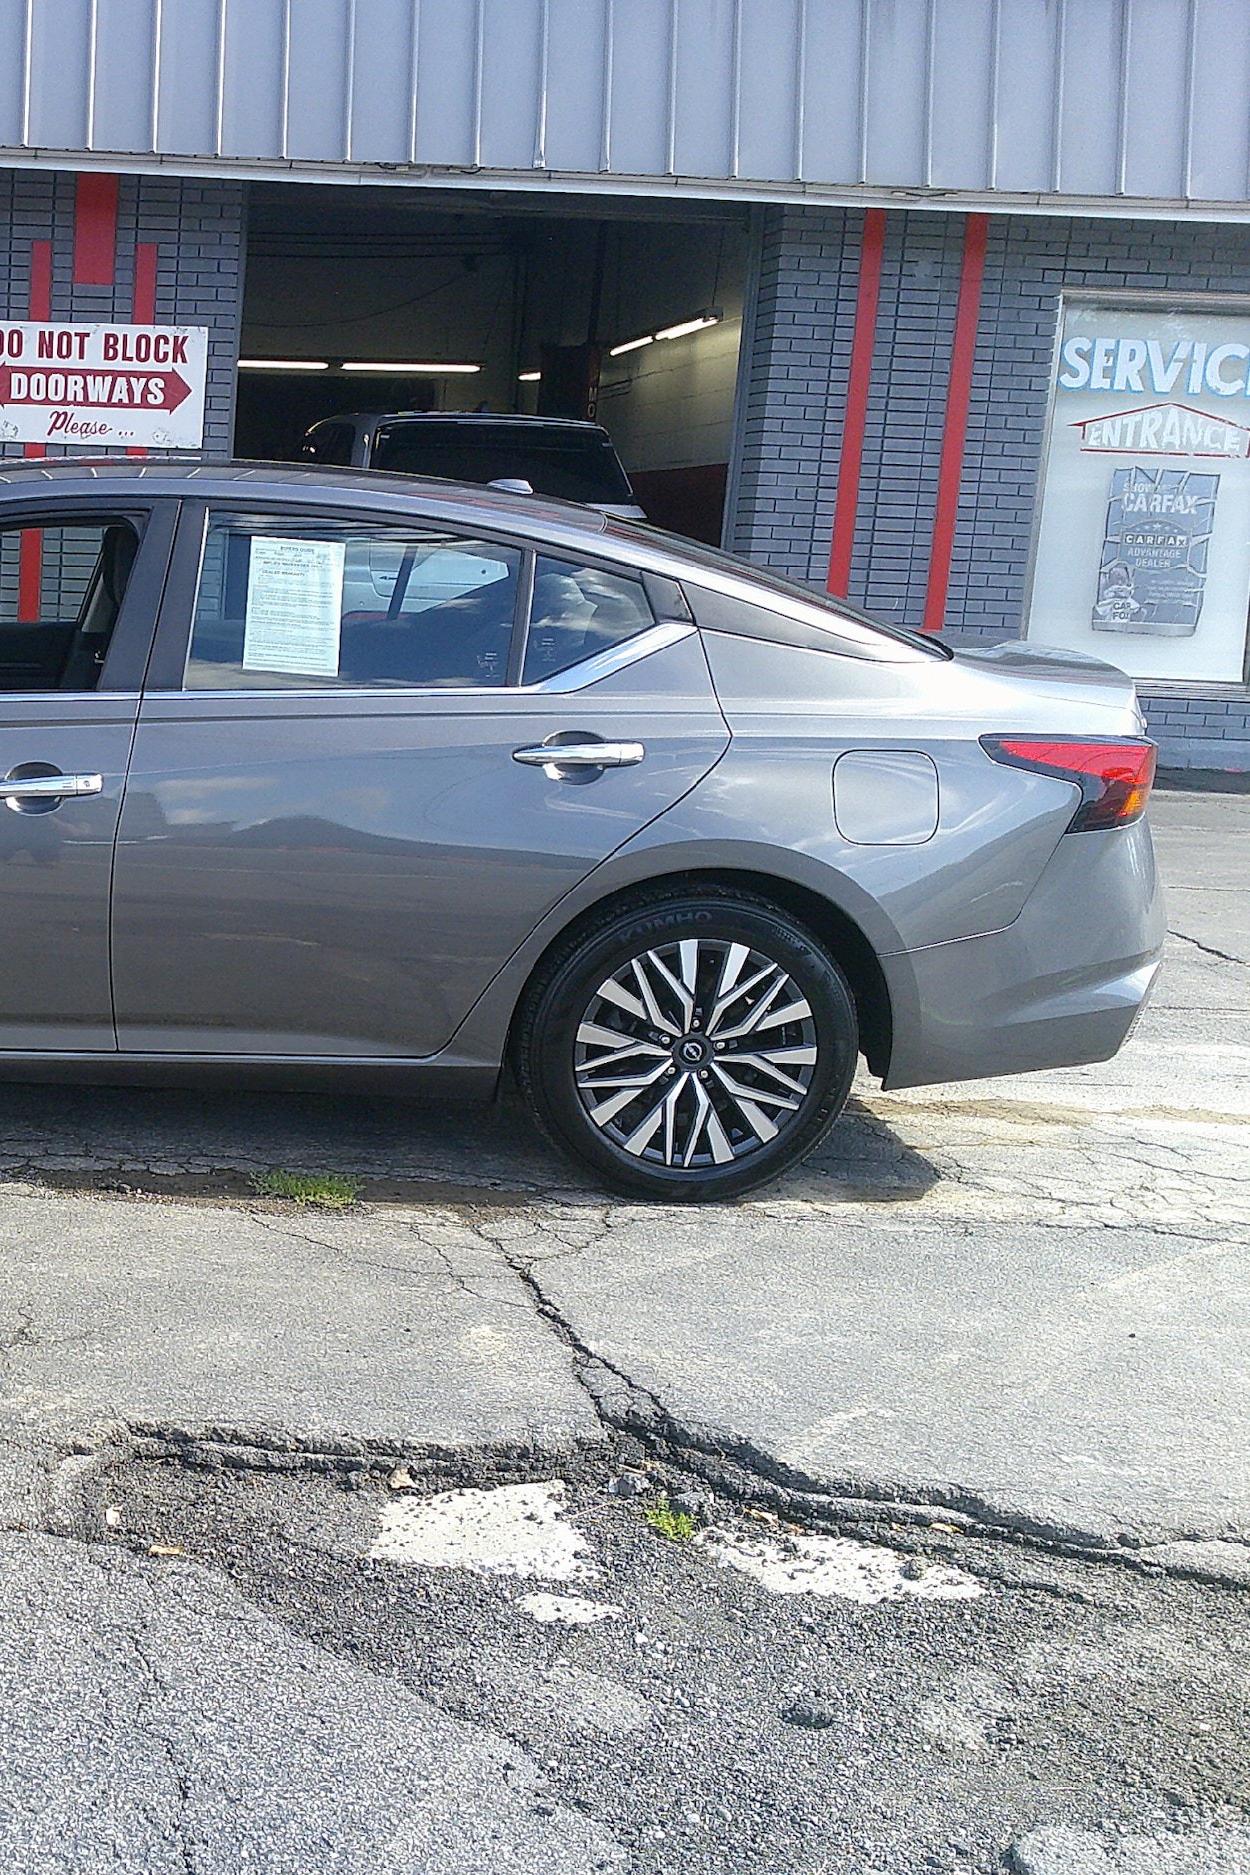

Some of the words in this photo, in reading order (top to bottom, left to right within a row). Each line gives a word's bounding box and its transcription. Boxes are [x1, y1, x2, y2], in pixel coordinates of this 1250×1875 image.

[38, 330, 90, 360] NOT
[103, 332, 189, 363] BLOCK
[1059, 336, 1250, 397] SERVIC
[10, 372, 165, 405] DOORWAYS
[47, 411, 113, 437] Please
[1088, 408, 1241, 451] ENTRANCE
[1123, 493, 1198, 515] CARFAX
[1125, 534, 1187, 547] CARFAX
[1127, 547, 1182, 559] ADVANTAGE
[1135, 558, 1171, 568] DEALER
